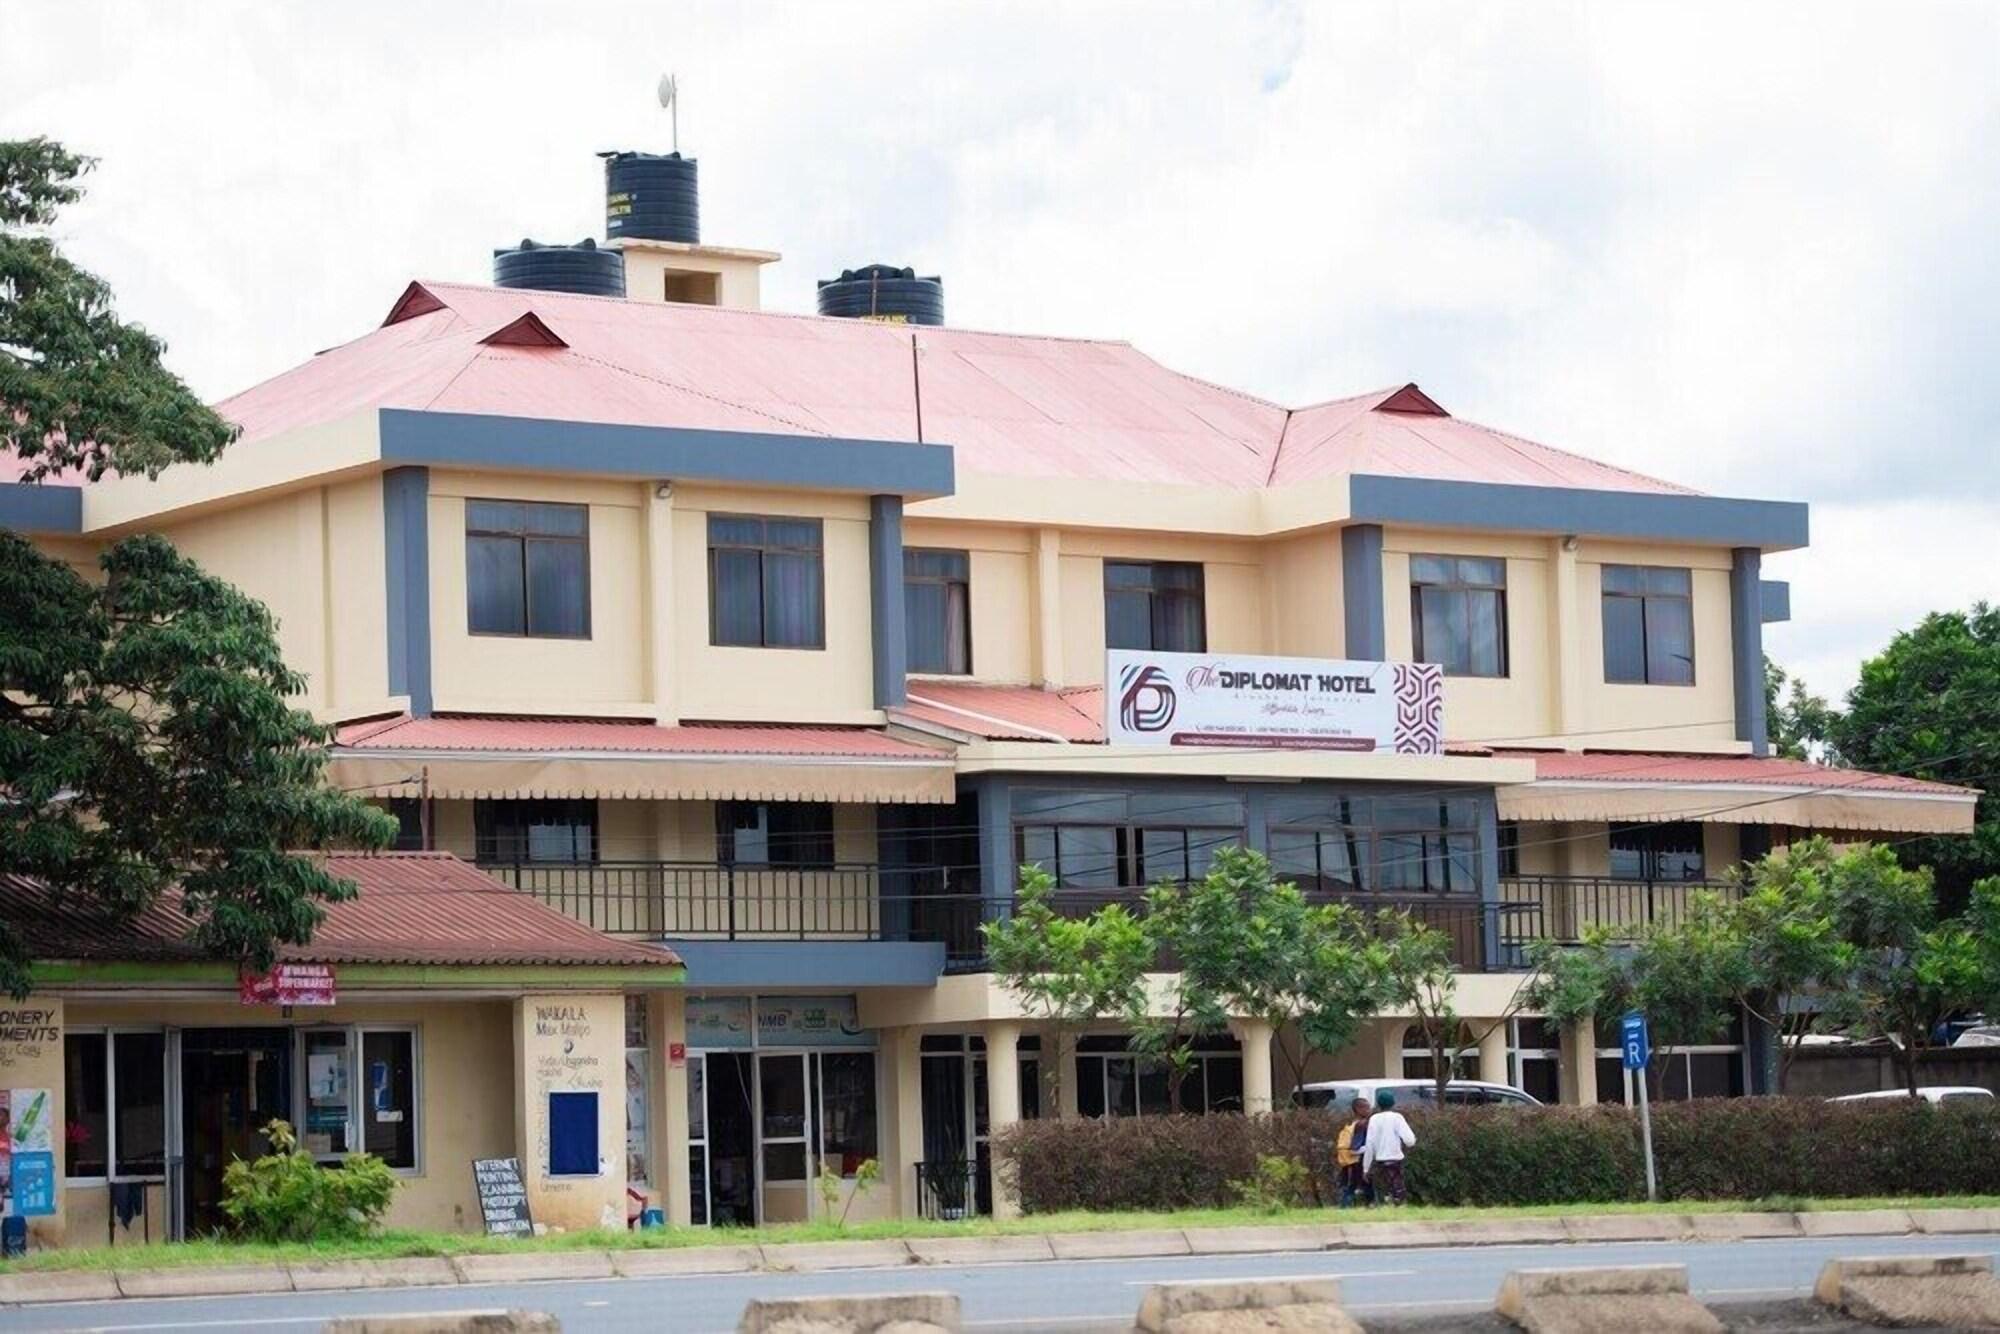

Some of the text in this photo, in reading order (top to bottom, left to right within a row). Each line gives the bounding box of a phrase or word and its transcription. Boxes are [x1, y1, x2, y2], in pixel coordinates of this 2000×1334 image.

[1186, 664, 1376, 694] The DIPLOMAT HOTEL
[278, 977, 334, 989] SUPERMARKET
[535, 1006, 587, 1021] WAKALA
[757, 1013, 788, 1028] NMB
